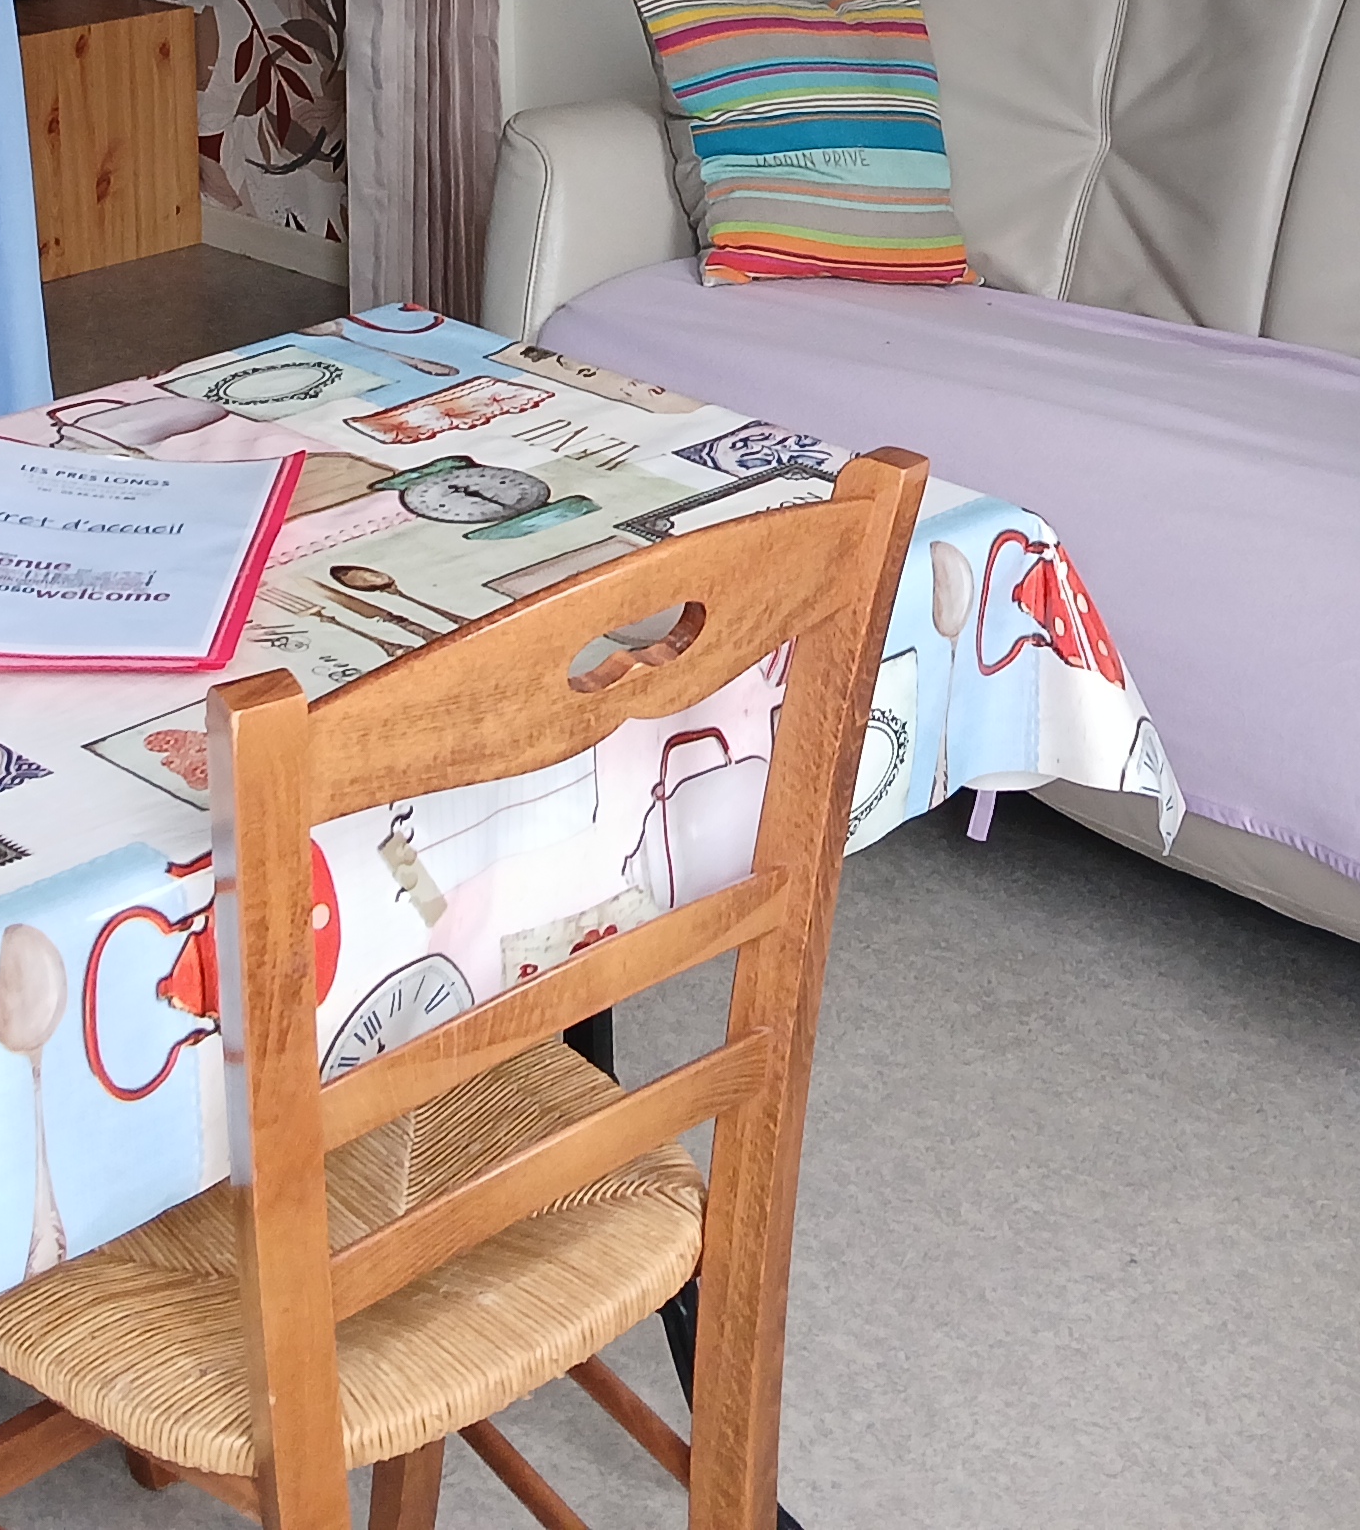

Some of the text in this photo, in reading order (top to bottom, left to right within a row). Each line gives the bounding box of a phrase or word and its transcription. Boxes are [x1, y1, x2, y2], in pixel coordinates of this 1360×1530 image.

[20, 464, 49, 475] LES
[55, 470, 97, 482] PRES
[103, 476, 171, 487] LONGS
[61, 518, 185, 536] d'accueil
[36, 587, 171, 602] welcome
